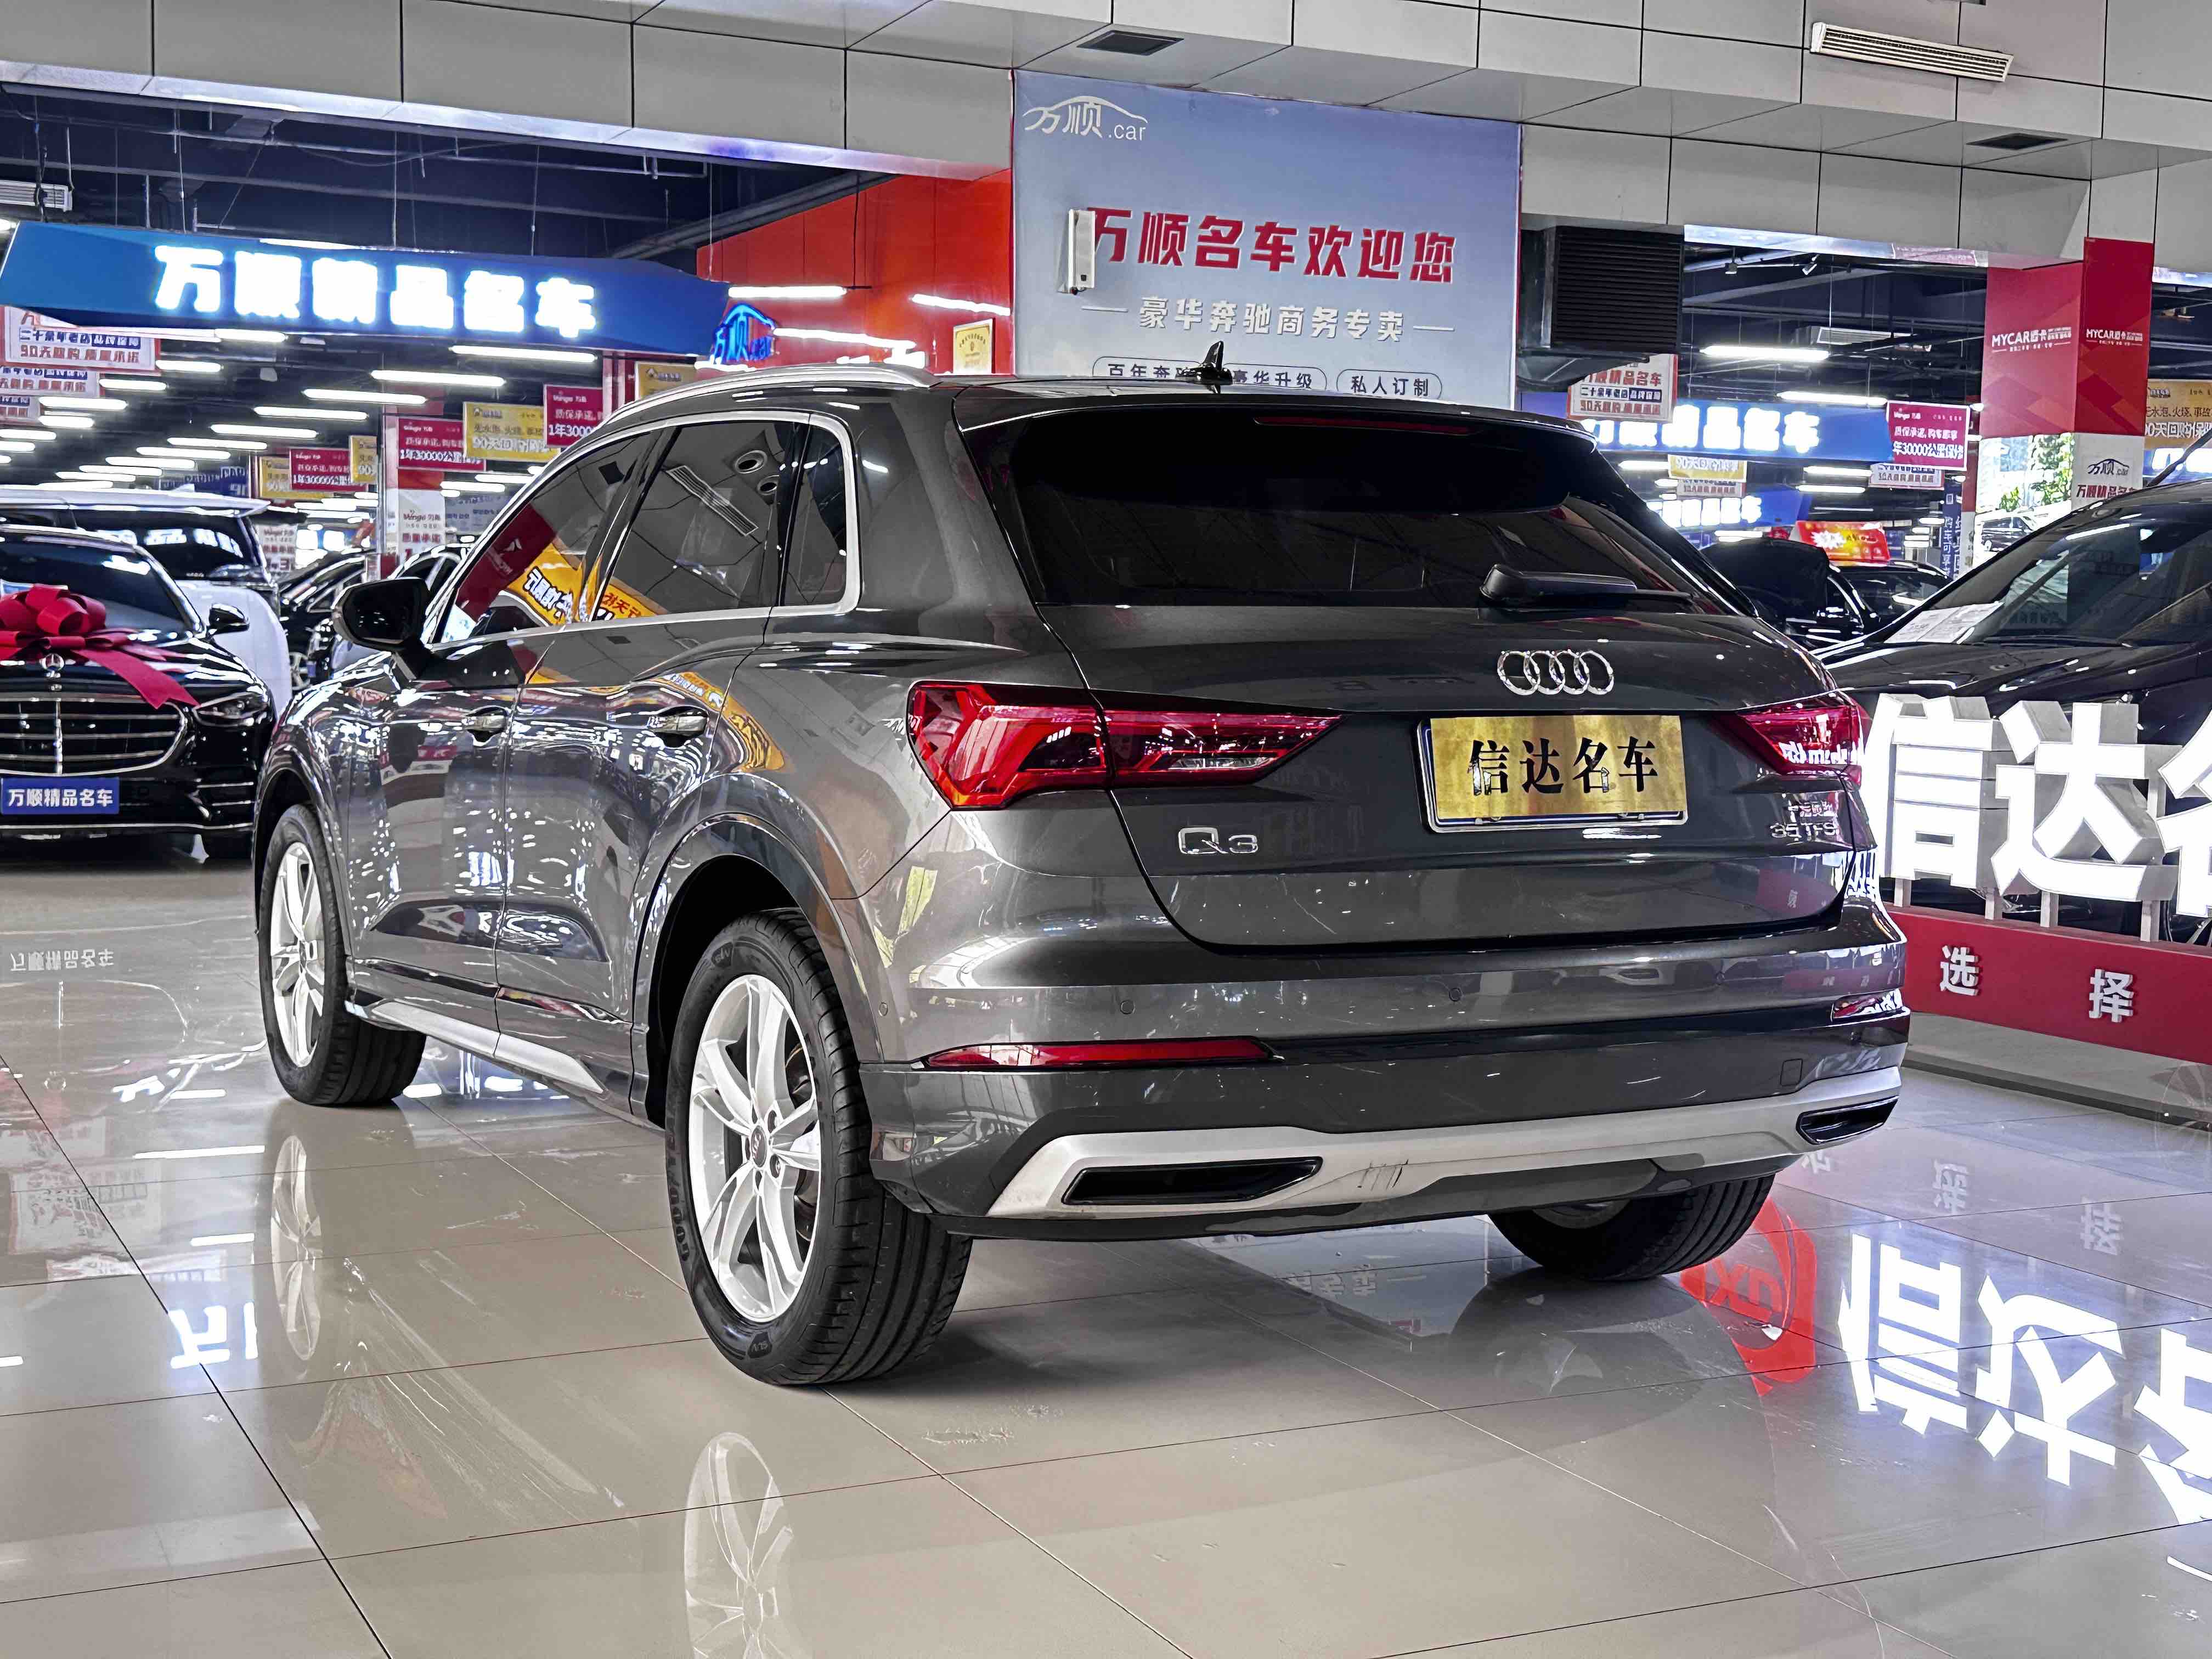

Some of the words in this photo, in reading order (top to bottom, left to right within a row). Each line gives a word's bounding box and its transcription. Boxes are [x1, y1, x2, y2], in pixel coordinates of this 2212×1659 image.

[1087, 207, 1455, 283] 万顺名车欢迎您
[1139, 296, 1404, 343] 豪华奔驰商务专卖
[1351, 375, 1429, 397] 私人订制
[1468, 736, 1658, 797] 信达名车
[8, 789, 113, 807] 万顺精品名车
[1178, 826, 1259, 855] Q3
[1939, 945, 1981, 996] 选
[2089, 968, 2134, 1023] 择
